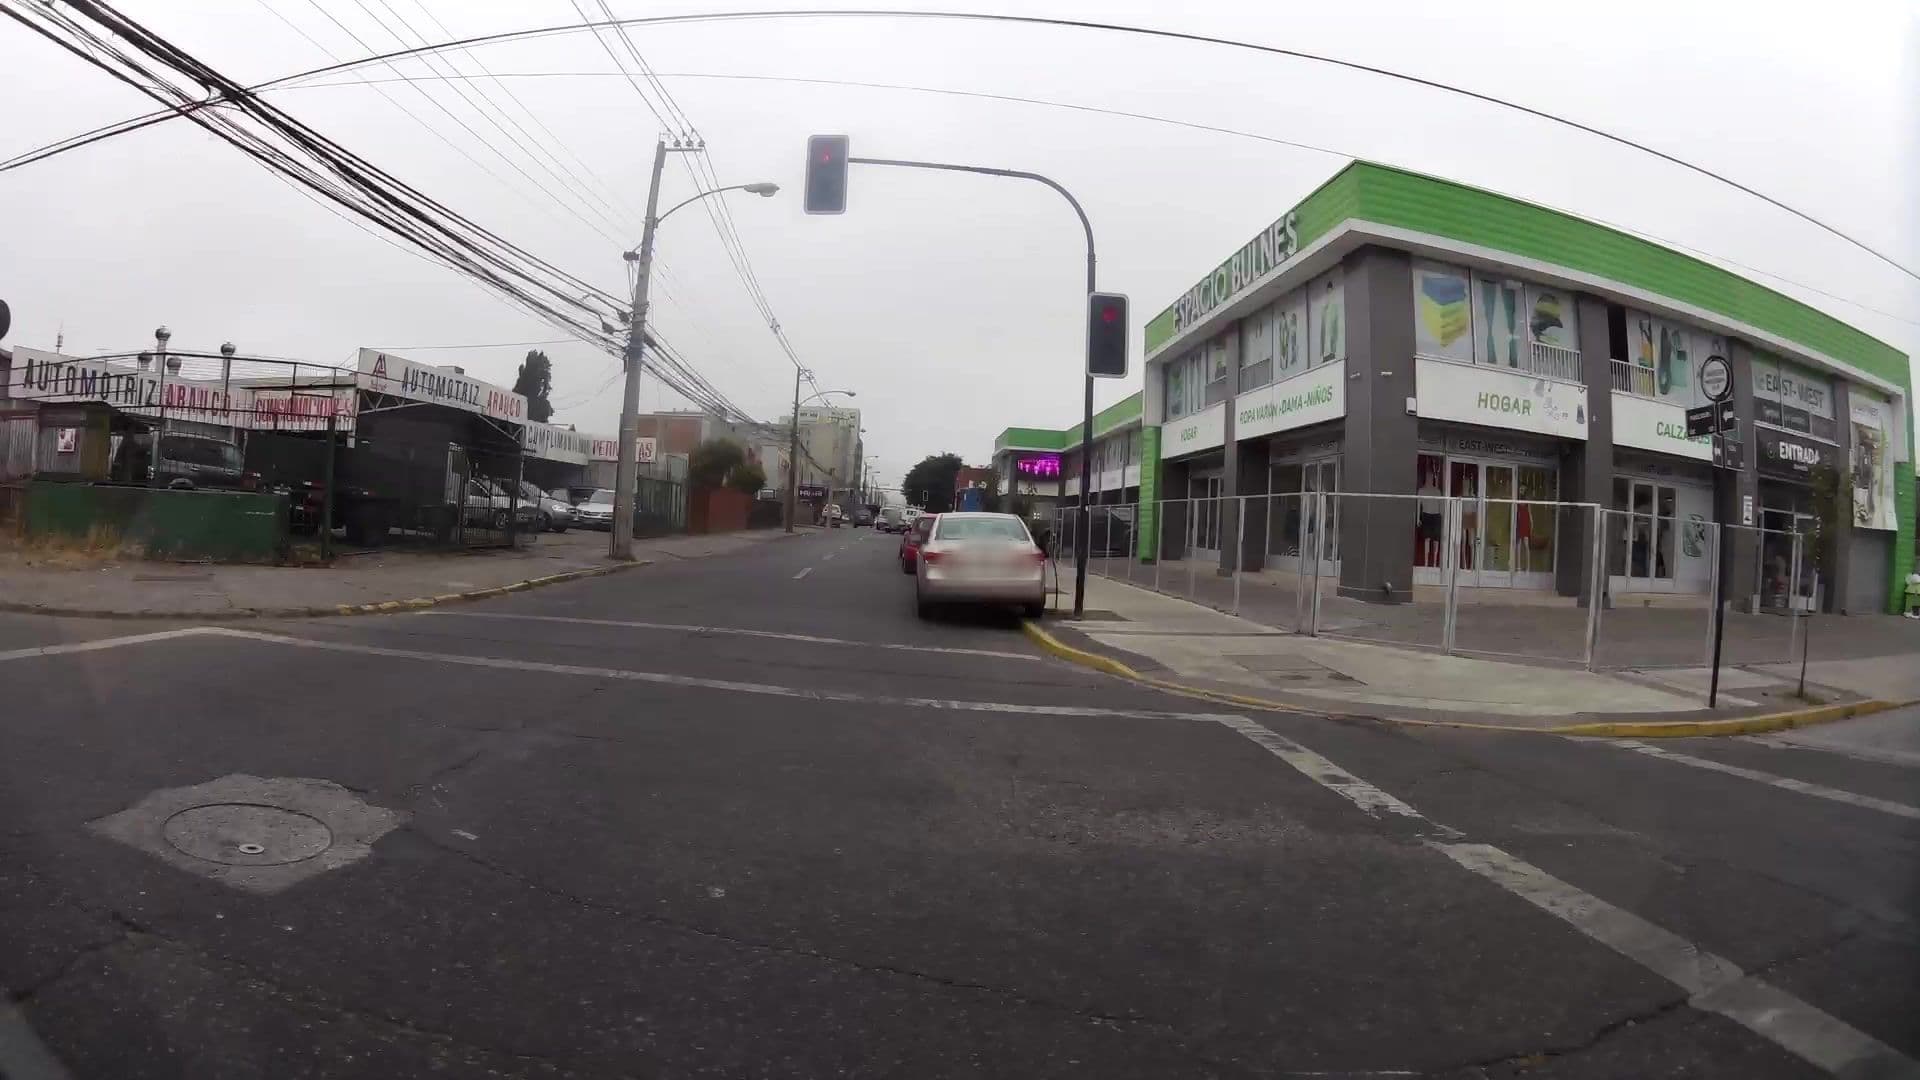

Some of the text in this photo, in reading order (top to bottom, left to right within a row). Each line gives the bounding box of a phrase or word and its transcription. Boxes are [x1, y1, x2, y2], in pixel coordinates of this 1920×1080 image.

[1173, 212, 1298, 332] ESPACIO BULNES
[24, 358, 157, 406] AUTOMOTRIZ
[402, 366, 480, 406] AUTOMOTRIZ
[487, 390, 521, 417] ARAUCO
[1477, 391, 1532, 416] HOGAR
[1656, 421, 1711, 445] CALZAS
[1779, 441, 1821, 465] ENTRADA
